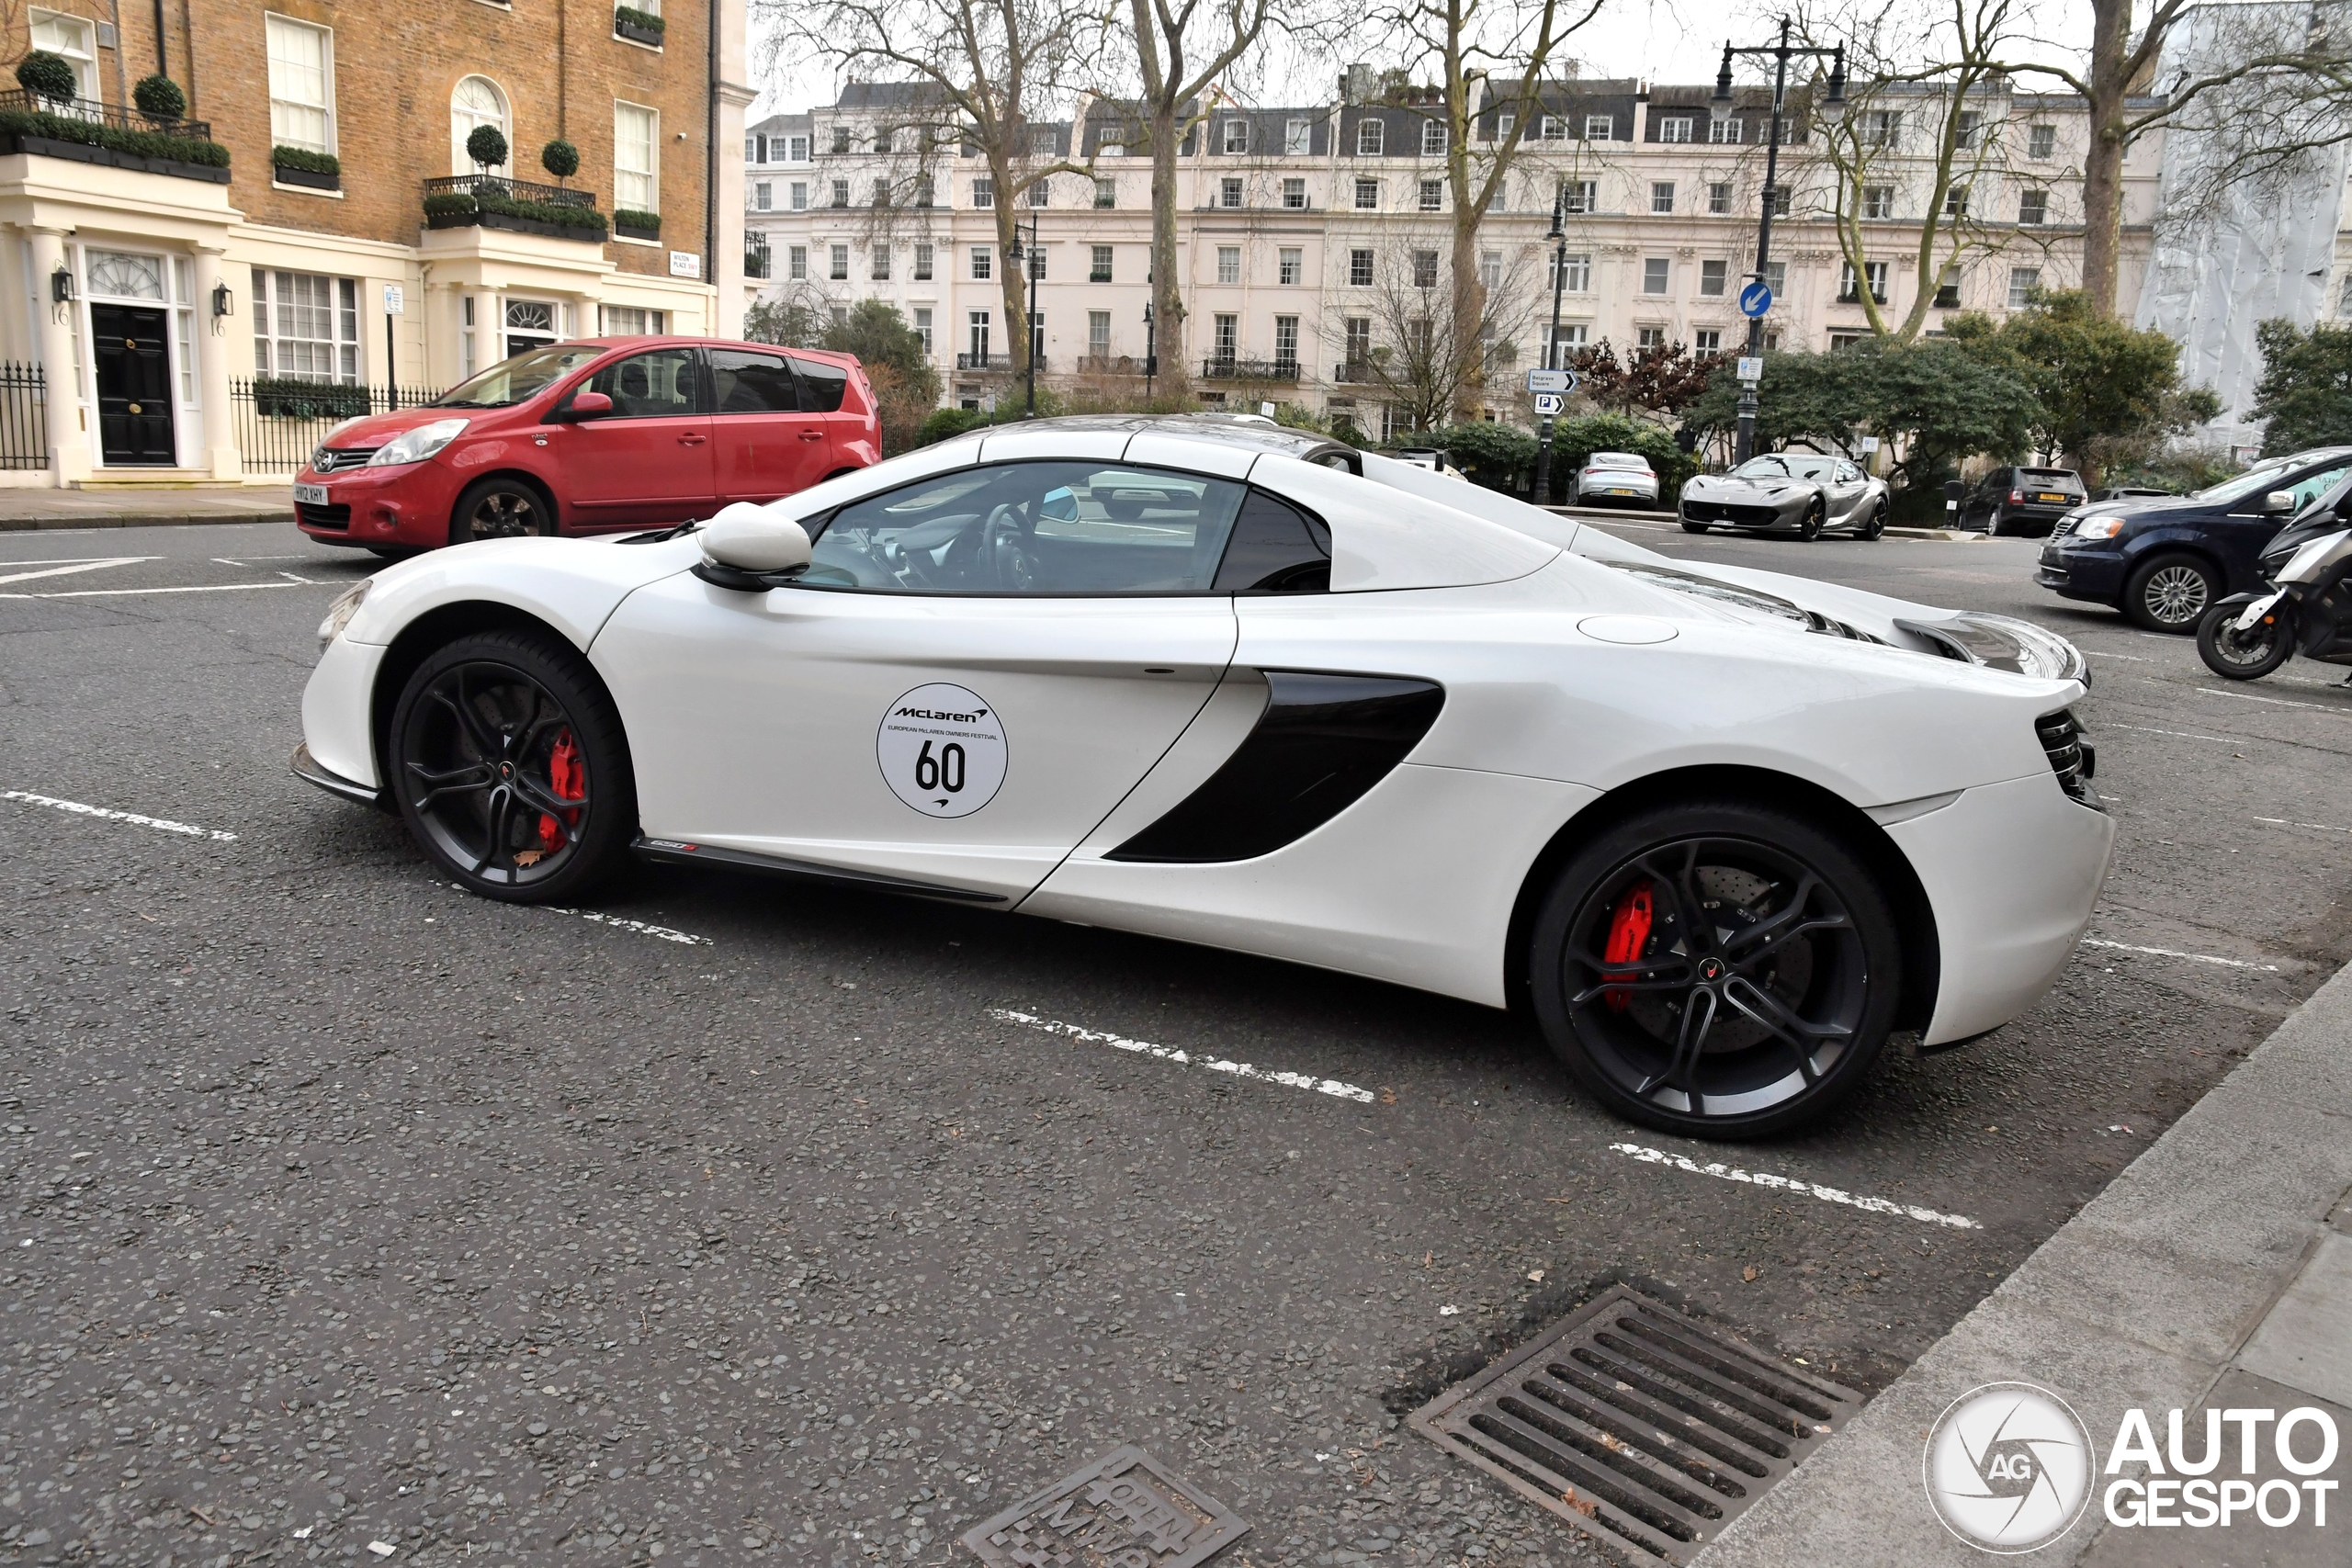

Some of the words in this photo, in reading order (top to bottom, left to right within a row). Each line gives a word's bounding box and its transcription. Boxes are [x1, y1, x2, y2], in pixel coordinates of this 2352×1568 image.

[51, 305, 69, 326] 16
[211, 319, 226, 337] 16
[1541, 397, 1549, 407] P
[309, 488, 322, 502] XHY
[894, 707, 977, 722] McLaren
[888, 725, 917, 733] EUROPEAN
[915, 740, 965, 793] 60
[1110, 1484, 1183, 1537] OPEN
